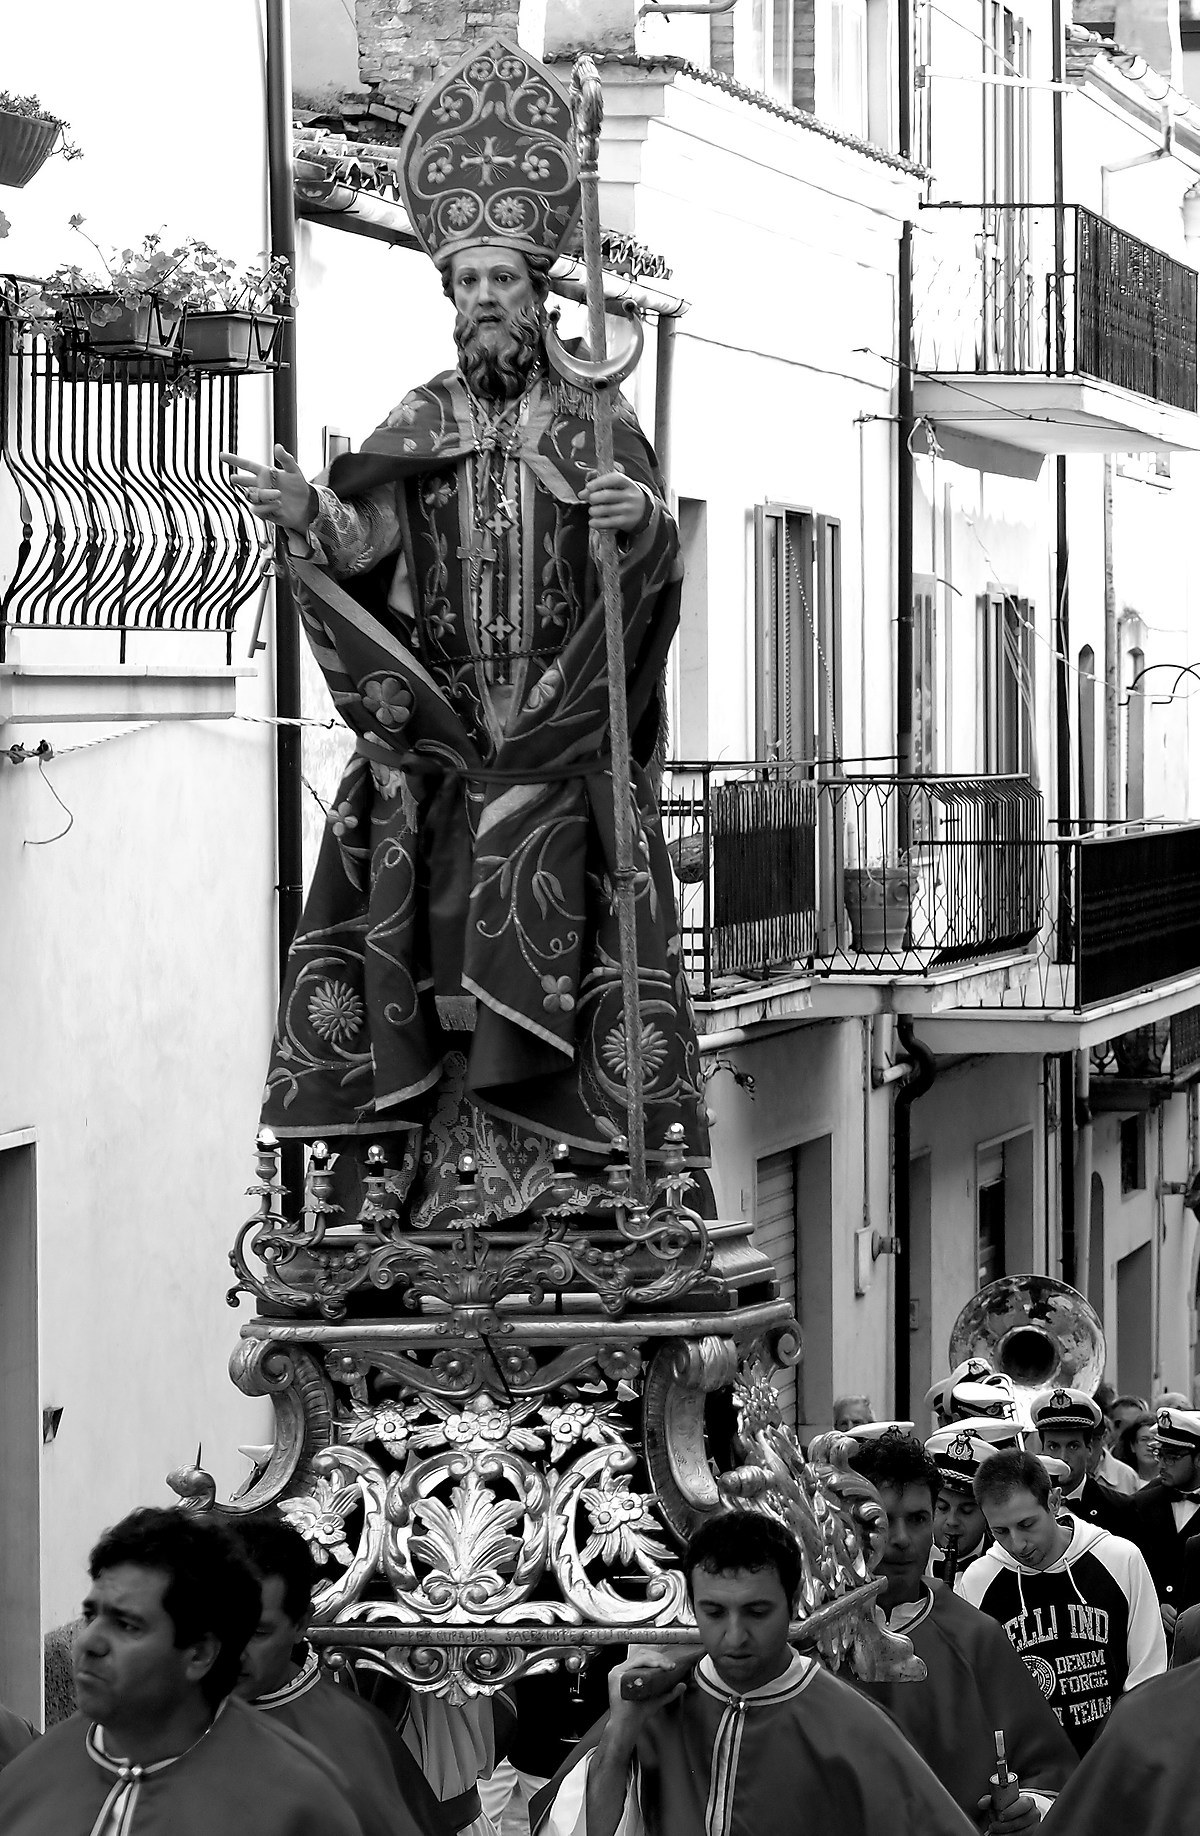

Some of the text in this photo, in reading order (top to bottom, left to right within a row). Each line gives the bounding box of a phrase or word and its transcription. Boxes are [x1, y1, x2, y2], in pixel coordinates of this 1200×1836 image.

[1067, 1603, 1109, 1645] IND
[1055, 1649, 1106, 1675] DENIM
[1058, 1669, 1109, 1696] FORGE
[1069, 1695, 1112, 1726] TEAM
